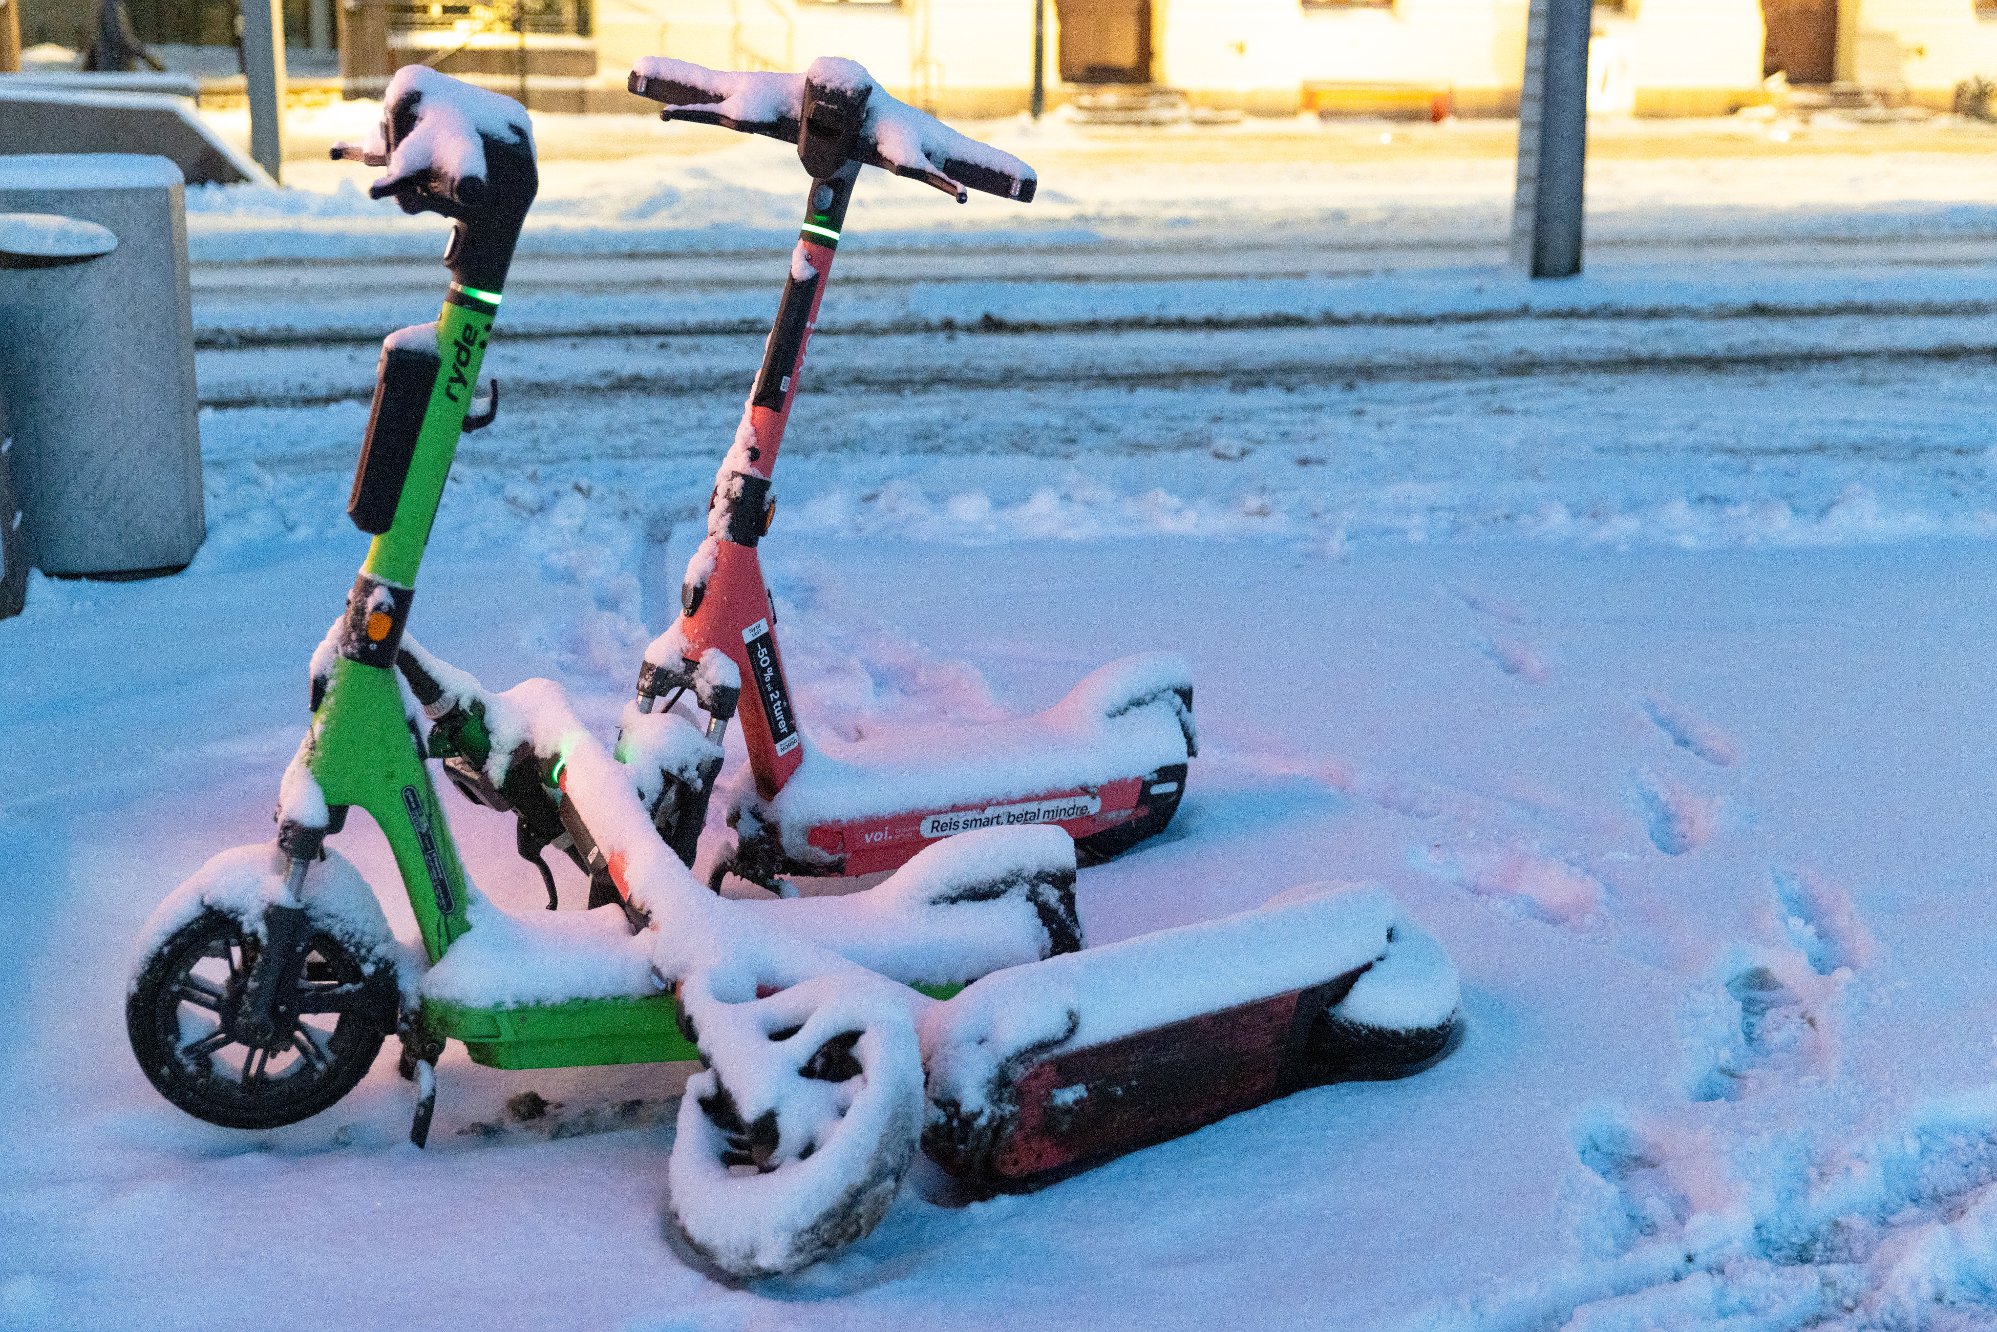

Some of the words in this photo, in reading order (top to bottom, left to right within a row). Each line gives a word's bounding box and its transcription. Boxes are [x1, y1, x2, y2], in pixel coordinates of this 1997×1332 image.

[445, 323, 478, 402] ryde
[769, 690, 780, 701] 2
[773, 700, 788, 733] turer
[930, 818, 960, 834] Reis
[962, 813, 1004, 830] smart,
[1006, 808, 1041, 825] betal
[1042, 804, 1091, 820] mindre.
